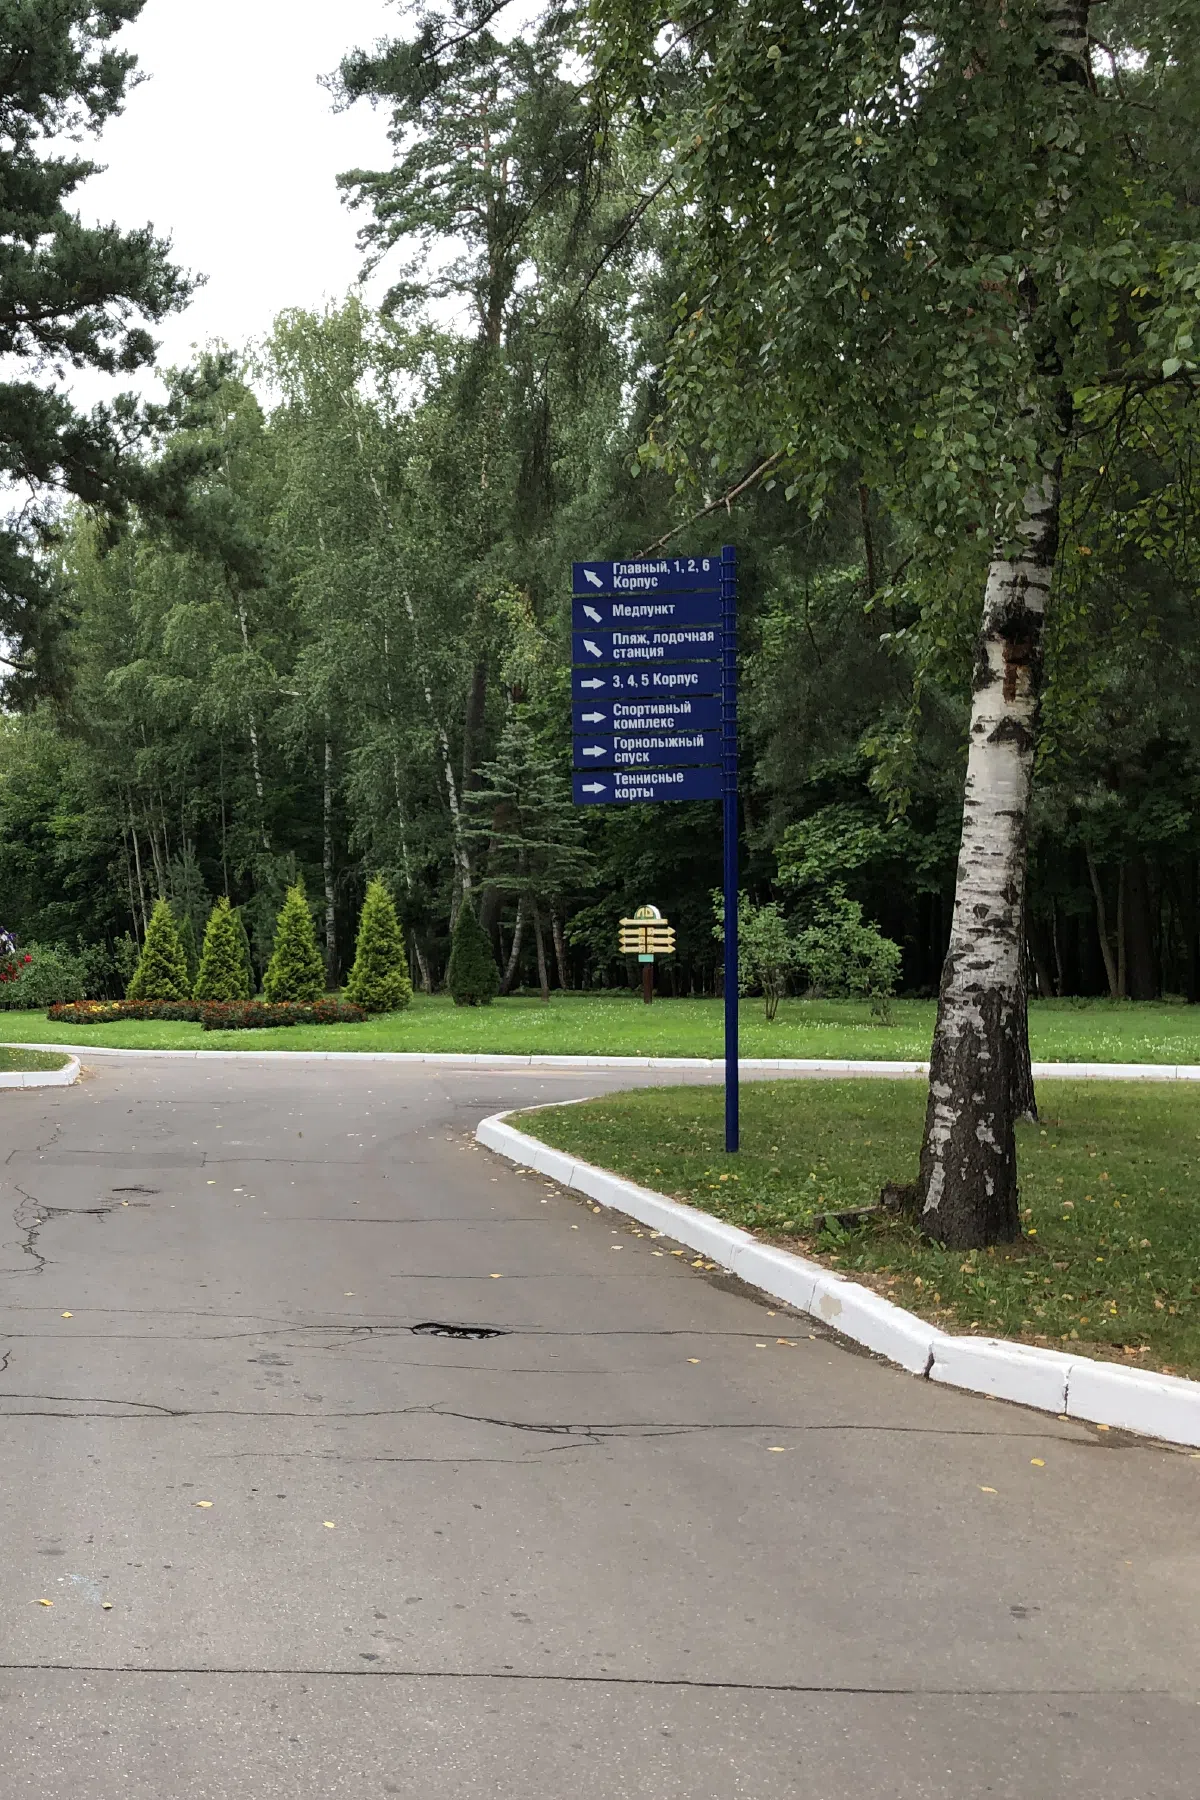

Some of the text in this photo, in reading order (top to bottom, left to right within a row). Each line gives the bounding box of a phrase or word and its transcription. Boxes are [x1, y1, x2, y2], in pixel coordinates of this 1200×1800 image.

[612, 559, 710, 575] Главный, 1, 2, 6
[613, 576, 659, 590] Корпус
[612, 603, 676, 618] Медпункт
[612, 631, 714, 646] Пляж, лодочная
[613, 647, 664, 659] станция
[612, 672, 699, 688] 3, 4, 5 Корпус
[613, 700, 692, 718] Спортивный
[613, 718, 675, 730] комплекс
[613, 734, 704, 751] Горнолыжный
[614, 752, 650, 765] спуск
[613, 772, 684, 785] Теннисные
[614, 787, 654, 800] корты
